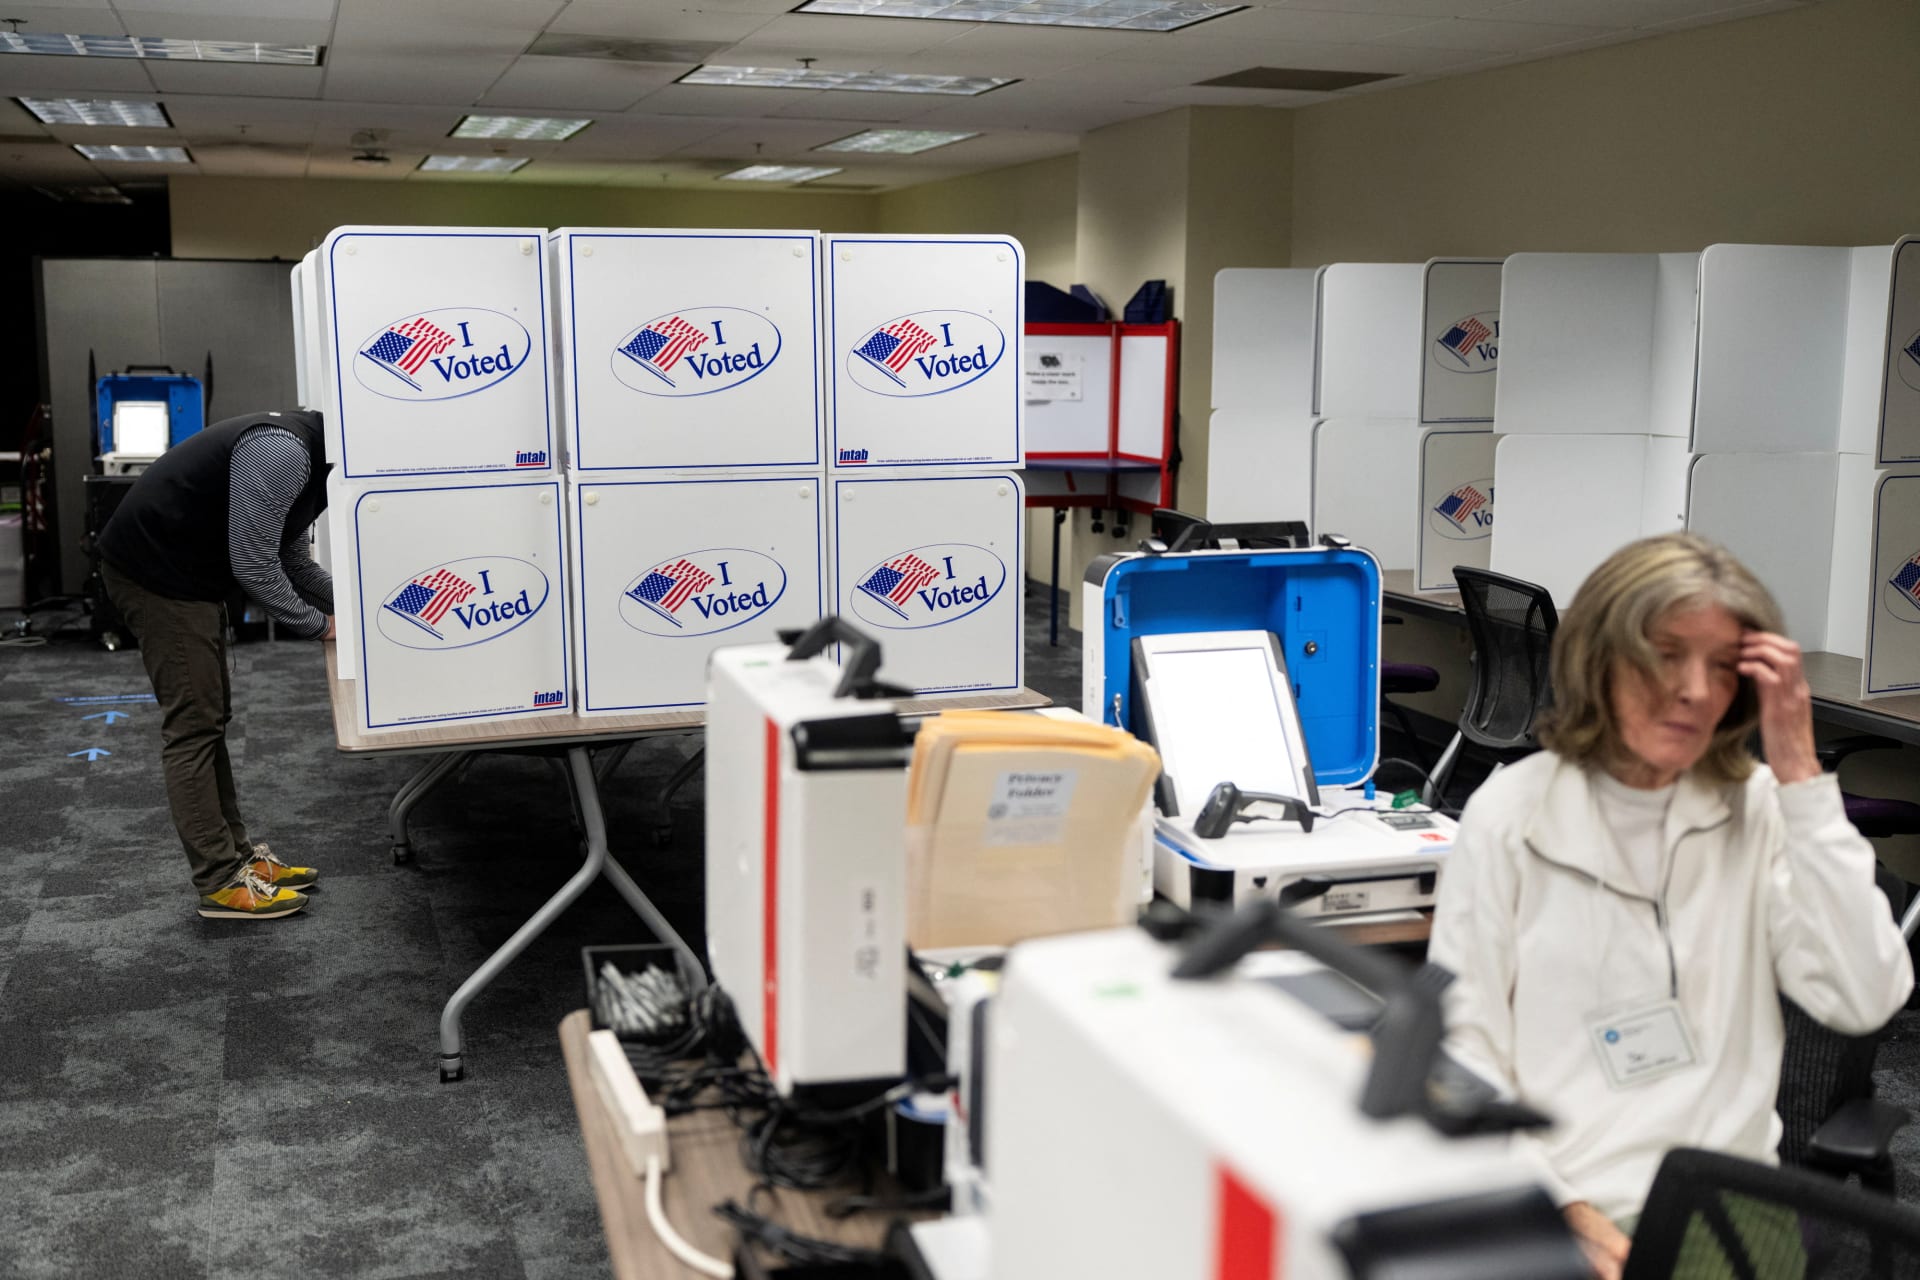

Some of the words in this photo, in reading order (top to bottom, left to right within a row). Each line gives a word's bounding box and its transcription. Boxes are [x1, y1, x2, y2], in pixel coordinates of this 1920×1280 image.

[457, 321, 474, 347] I
[711, 320, 725, 345] I
[940, 323, 954, 347] I
[430, 344, 513, 382] Voted
[684, 343, 764, 379] Voted
[914, 345, 988, 380] Voted
[515, 451, 546, 464] intab
[838, 448, 869, 461] intab
[717, 562, 732, 586] I
[943, 556, 957, 580] I
[478, 570, 494, 596] I
[917, 576, 989, 612] Voted
[452, 589, 533, 630] Voted
[691, 582, 769, 619] Voted
[533, 690, 563, 705] intab
